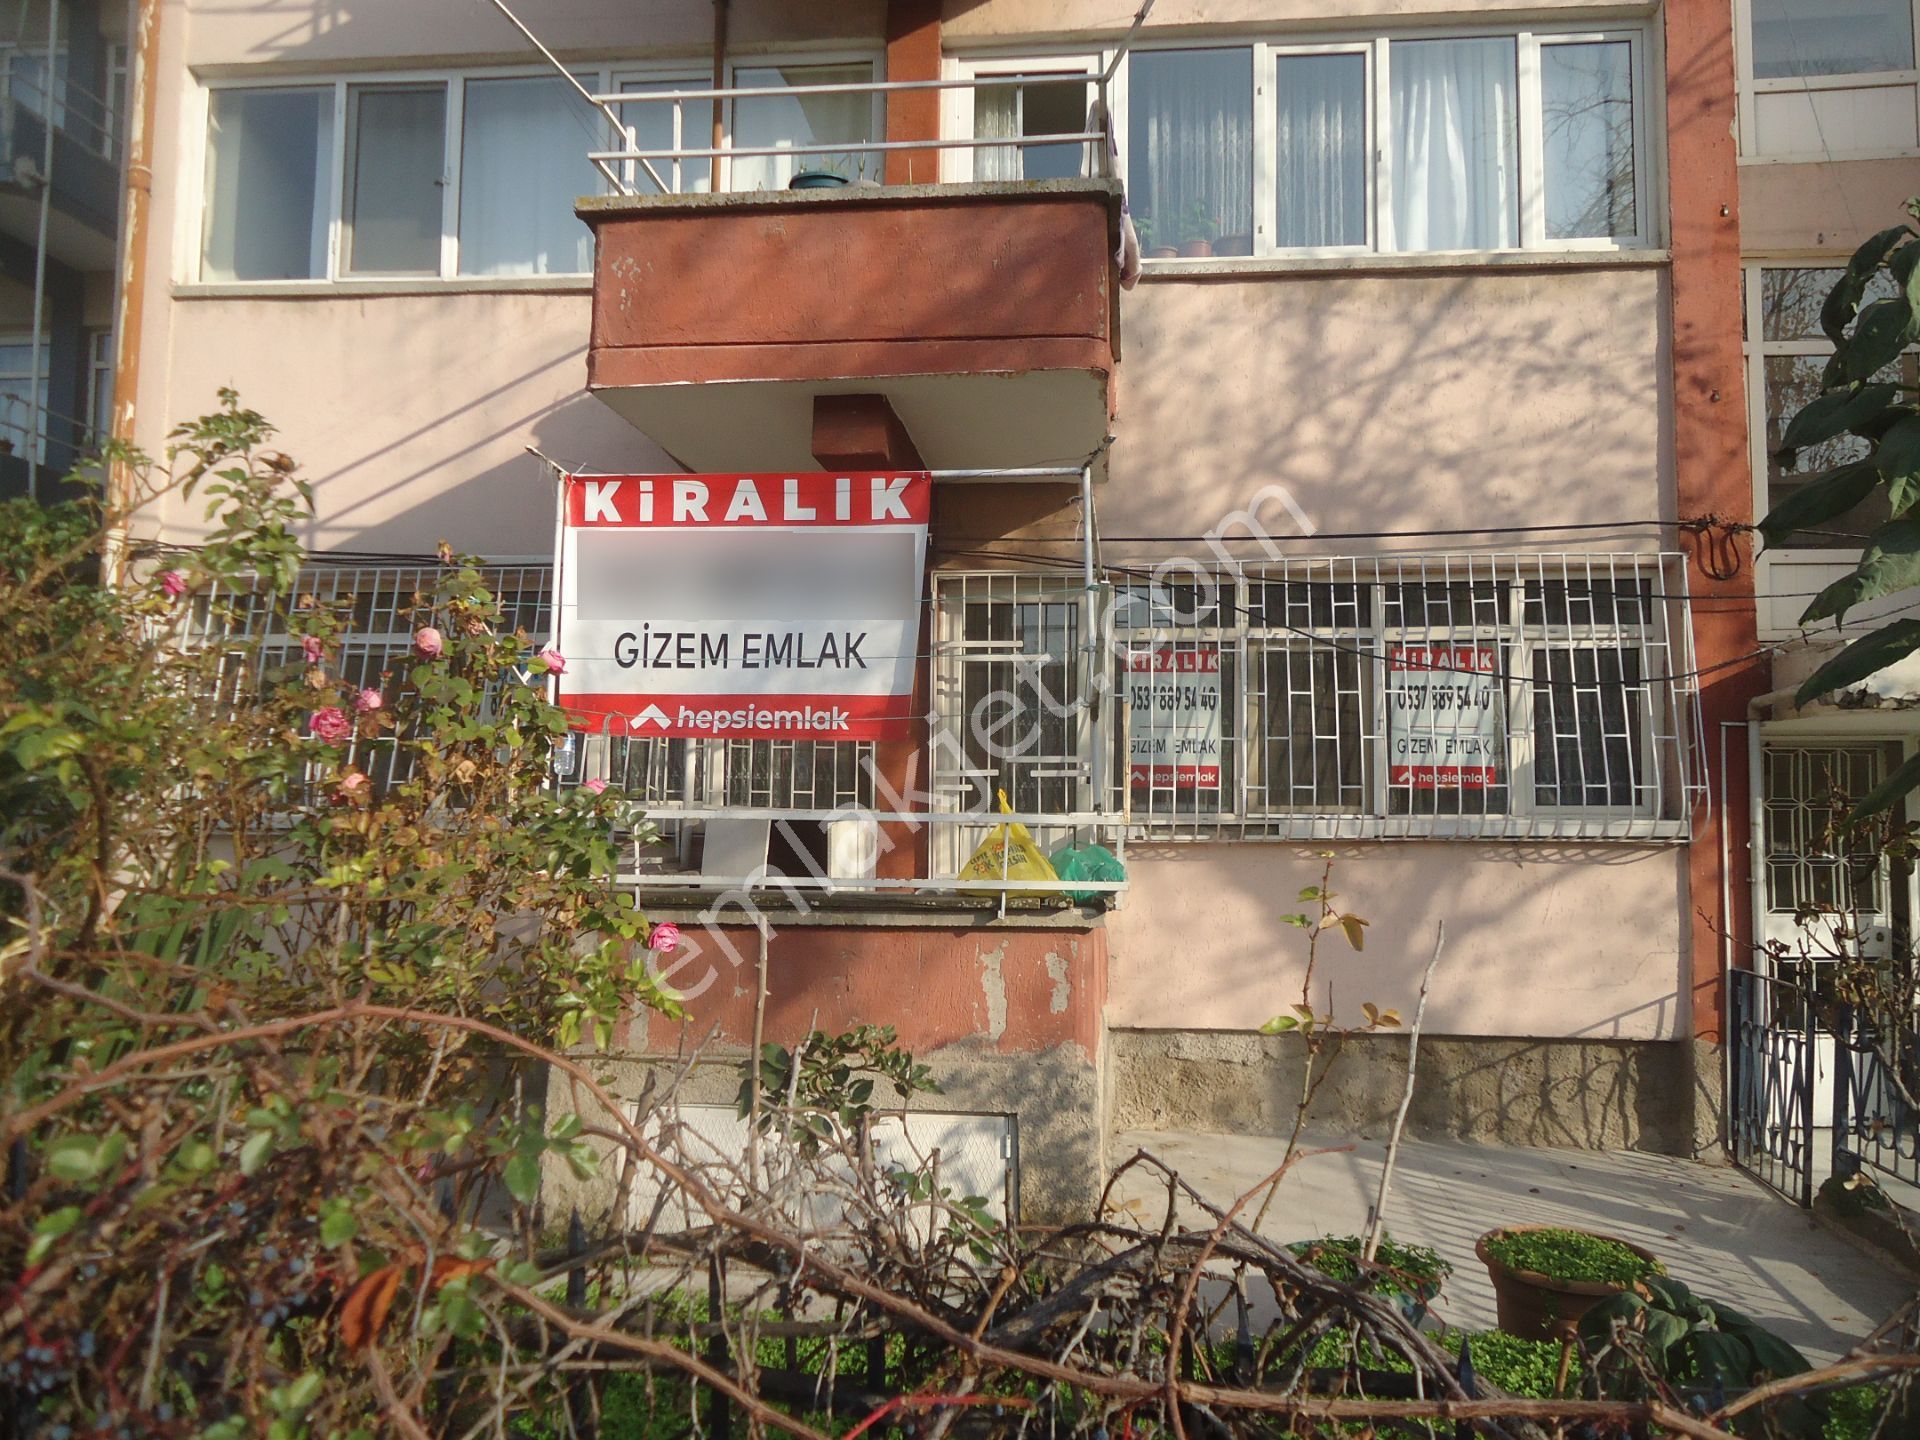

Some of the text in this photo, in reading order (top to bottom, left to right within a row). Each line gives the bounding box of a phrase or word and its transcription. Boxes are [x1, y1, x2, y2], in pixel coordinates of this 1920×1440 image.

[614, 622, 868, 669] GİZEM EMLAK
[1201, 686, 1217, 711] 40
[1397, 685, 1428, 710] 0537
[1456, 685, 1471, 710] 54
[677, 702, 850, 733] hepsiemlak
